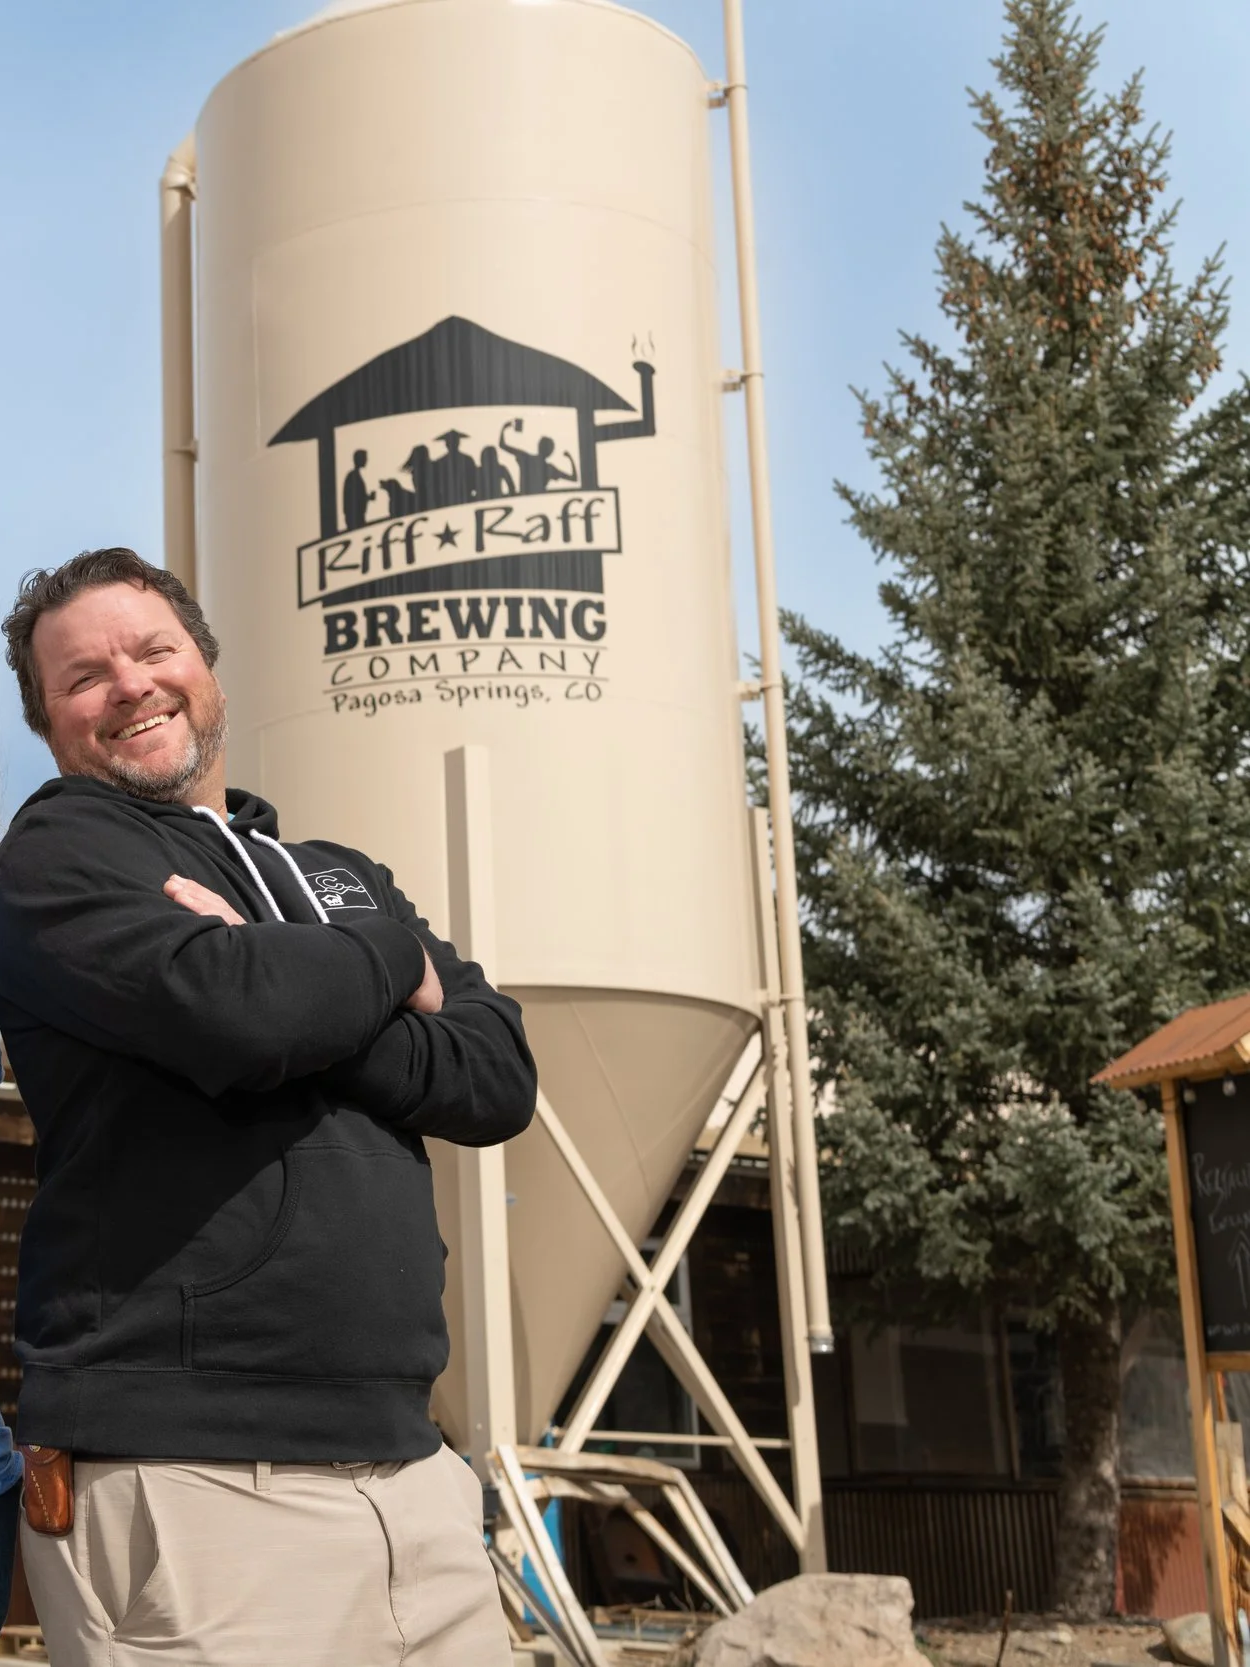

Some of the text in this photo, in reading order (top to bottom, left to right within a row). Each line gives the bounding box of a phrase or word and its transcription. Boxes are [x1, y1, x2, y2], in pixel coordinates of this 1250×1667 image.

[318, 497, 606, 591] Riff Raff
[322, 597, 607, 656] BREWING
[330, 647, 601, 686] COMPANY
[332, 679, 603, 717] Pagosa Springs, CO
